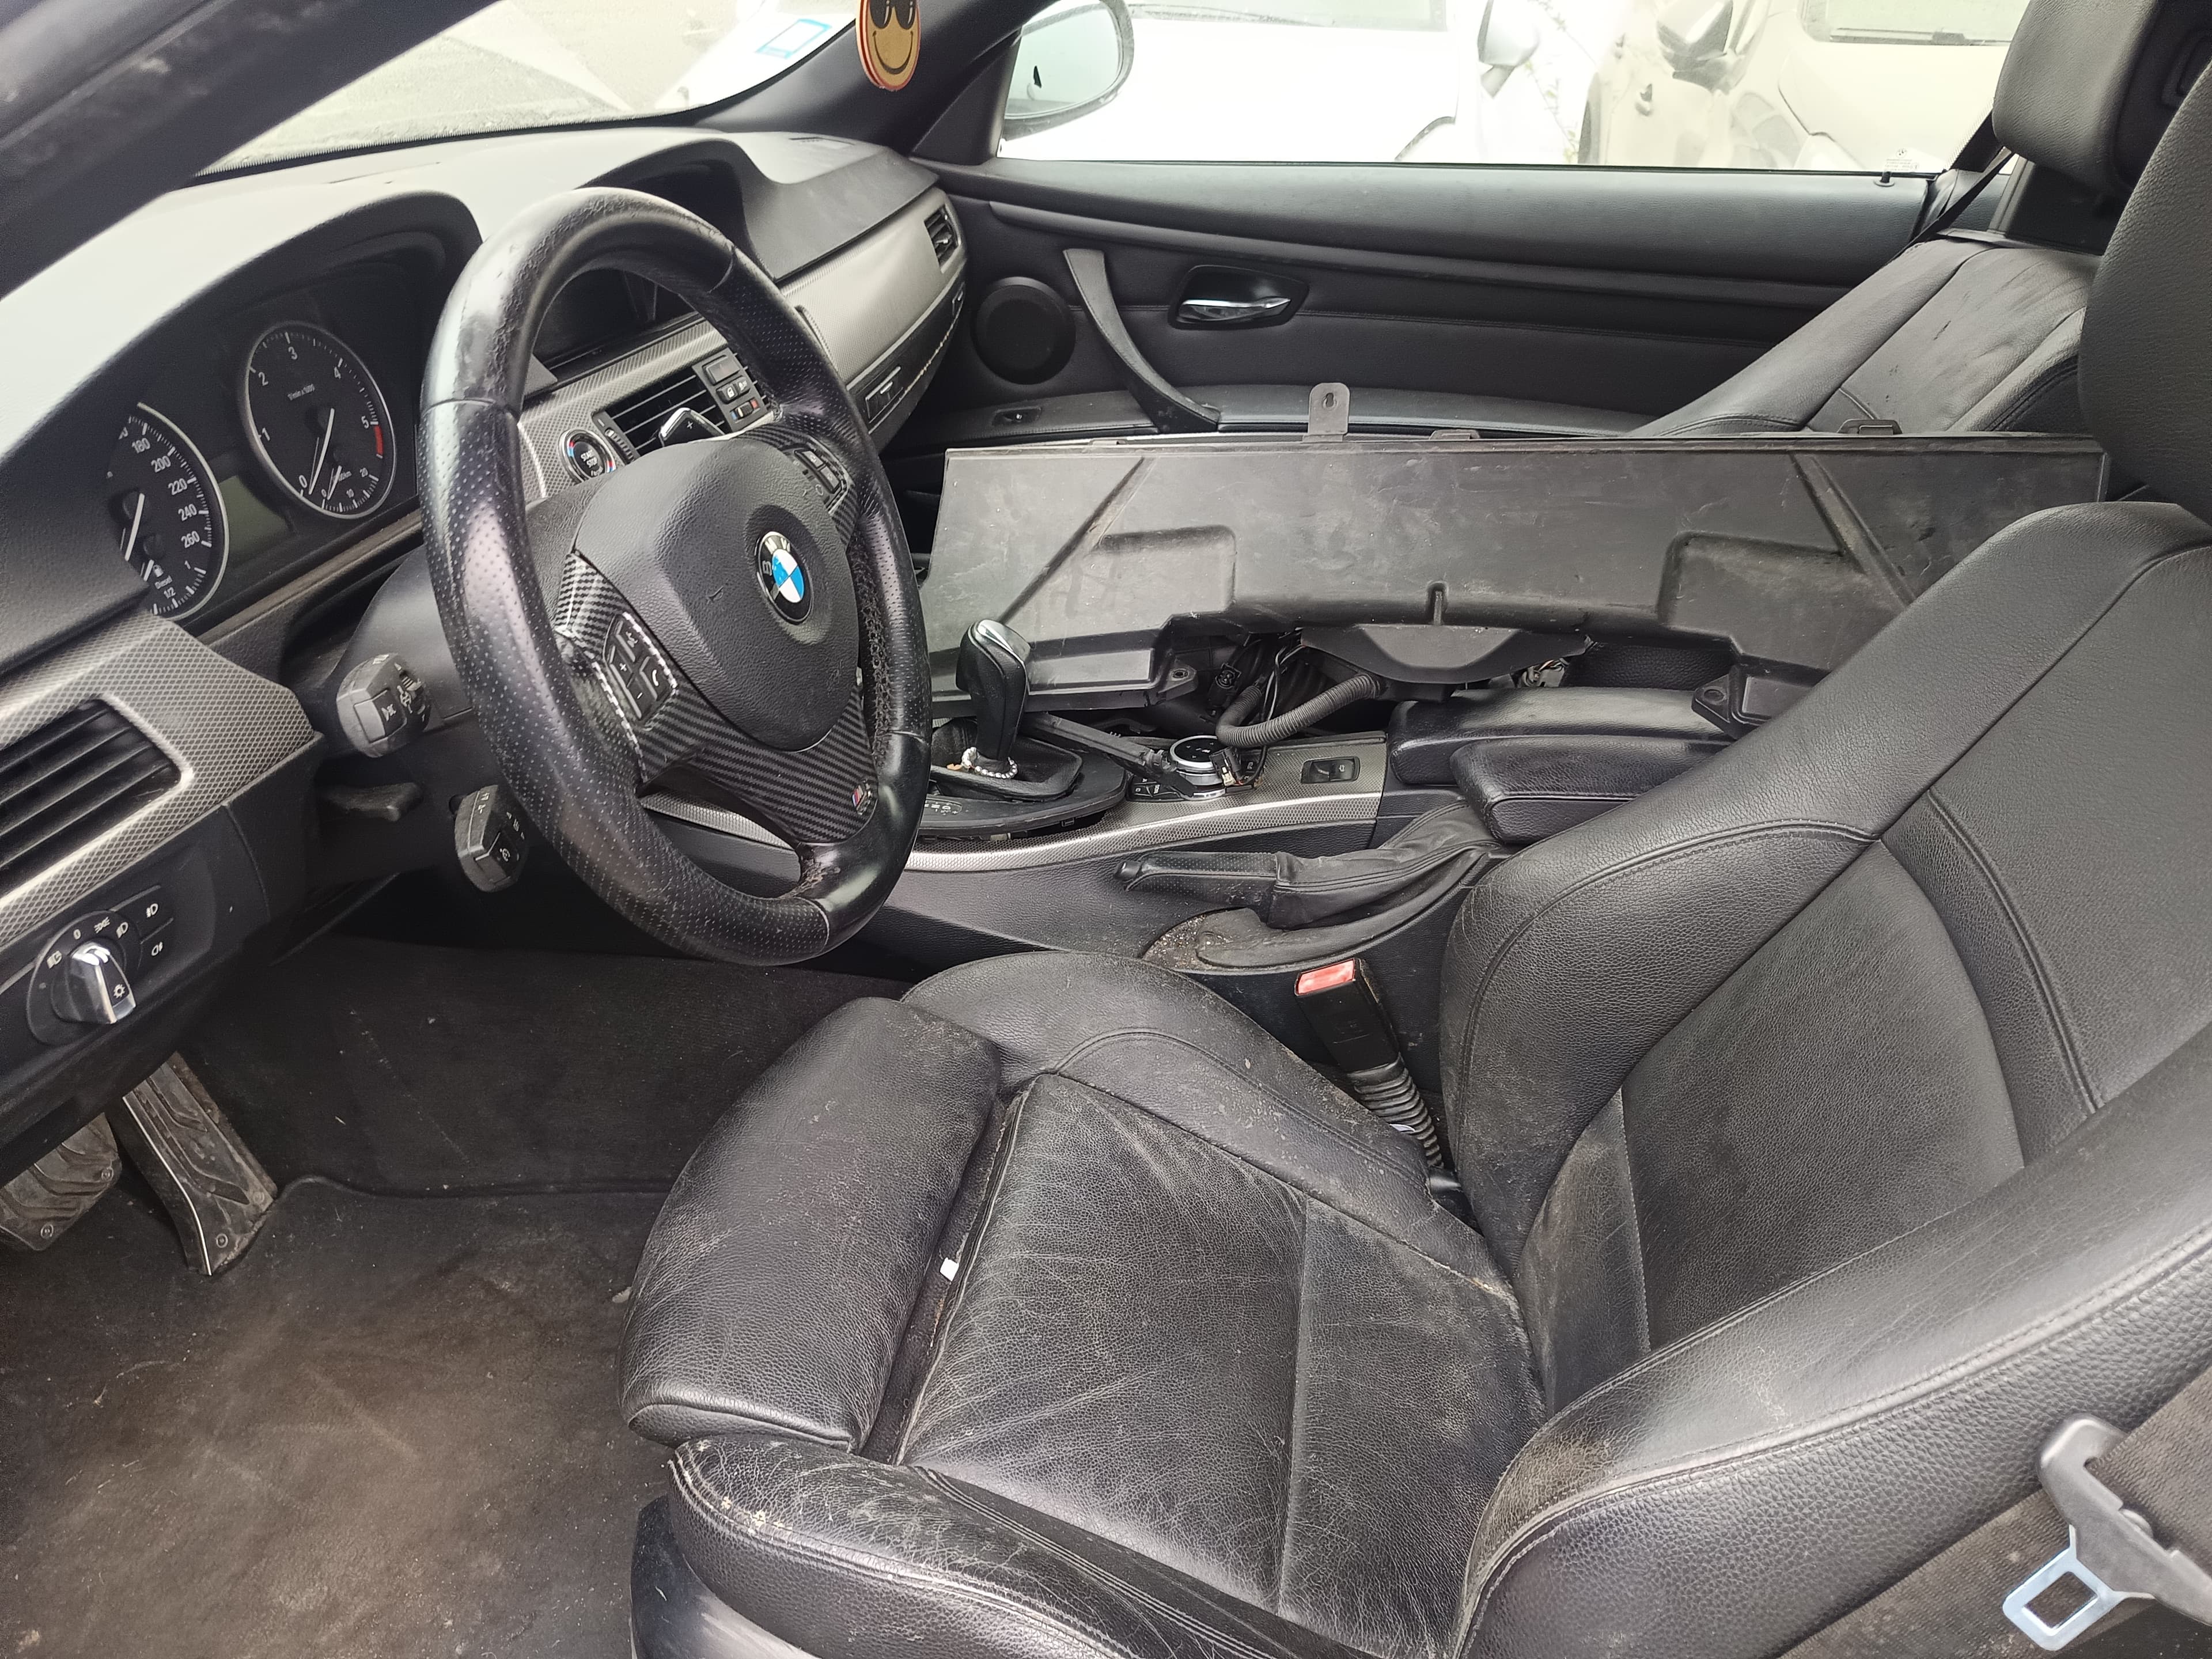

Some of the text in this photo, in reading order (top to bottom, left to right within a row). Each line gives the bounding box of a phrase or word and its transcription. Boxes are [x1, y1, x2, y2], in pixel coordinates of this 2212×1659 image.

[288, 346, 298, 360] 3
[259, 371, 269, 386] 2
[334, 366, 342, 380] 4
[361, 415, 369, 429] 5
[262, 427, 271, 441] 1
[131, 437, 151, 454] 180
[150, 455, 171, 473] 200
[168, 478, 188, 495] 220
[298, 475, 308, 488] 0
[177, 503, 197, 521] 240
[180, 530, 200, 548] 260
